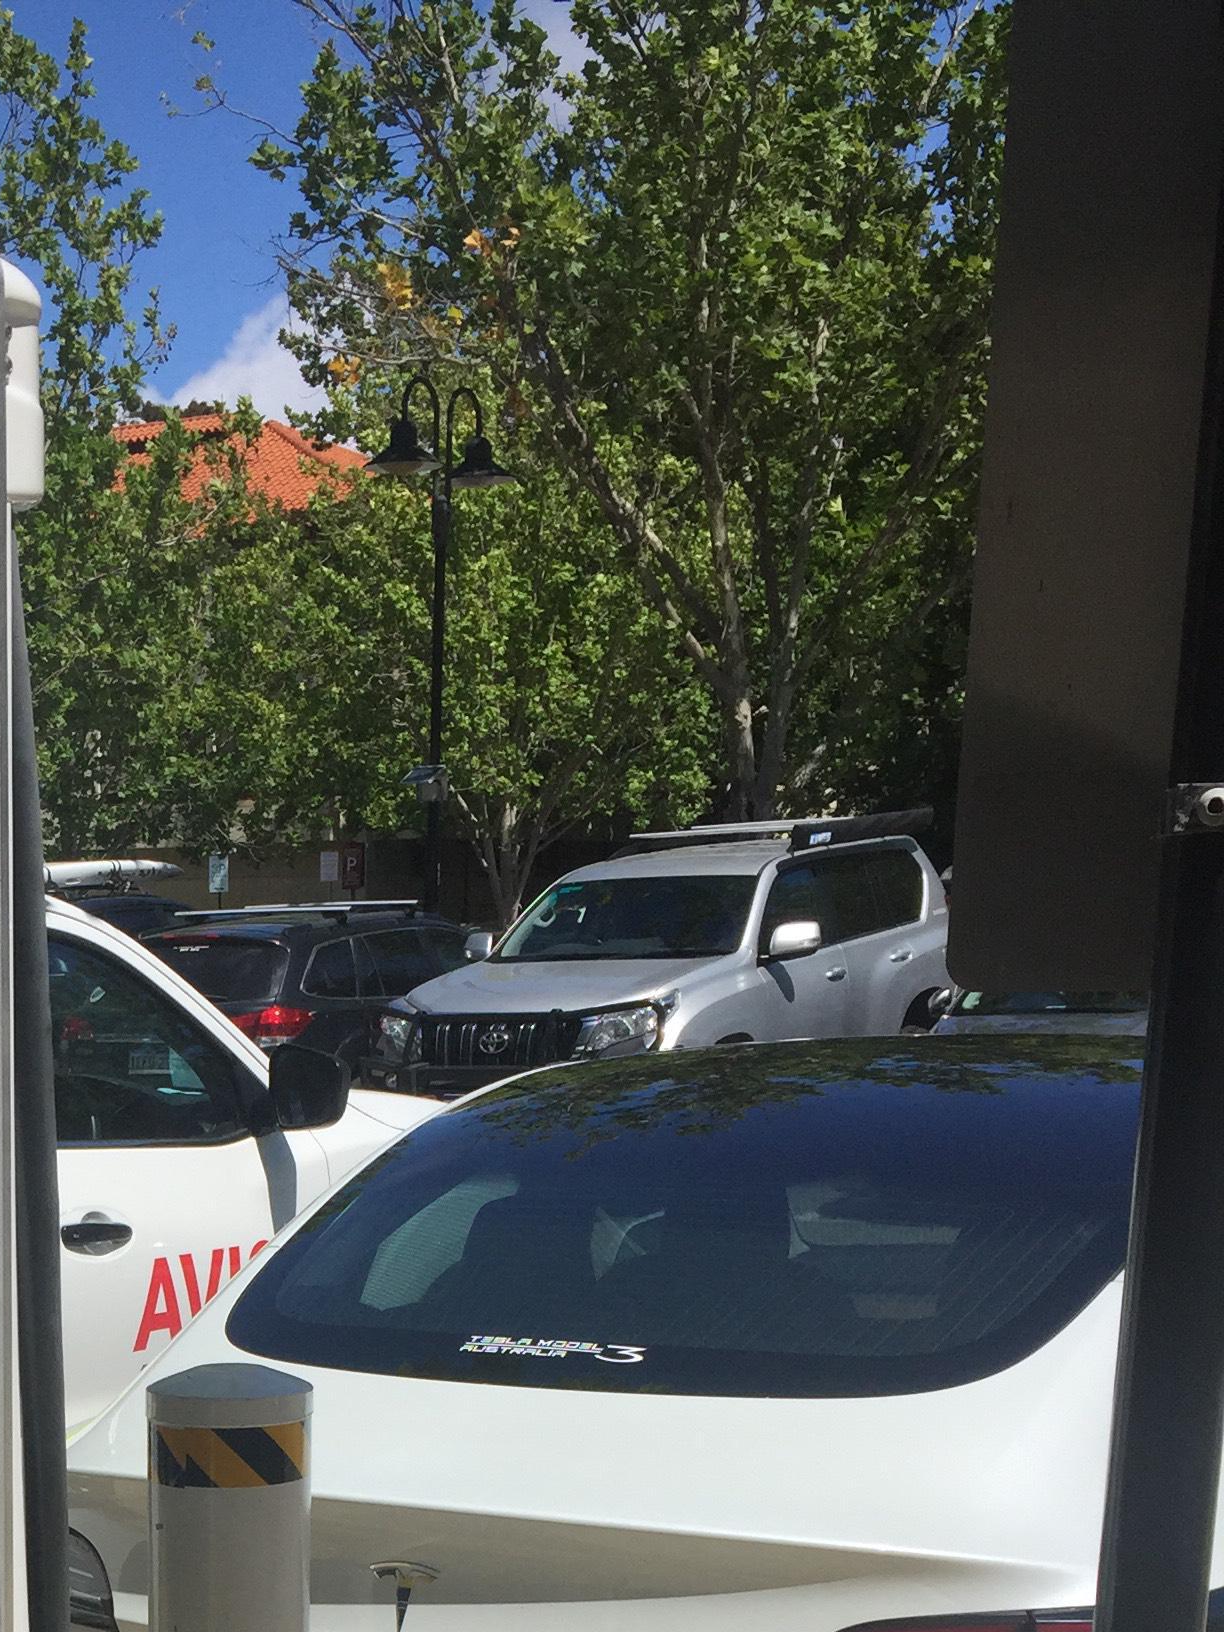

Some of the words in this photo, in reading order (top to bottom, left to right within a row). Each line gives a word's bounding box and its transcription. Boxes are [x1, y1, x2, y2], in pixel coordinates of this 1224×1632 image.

[132, 1239, 270, 1353] AV
[459, 1344, 567, 1359] AUSTRALIA
[470, 1336, 533, 1346] TESLA
[537, 1339, 604, 1351] MODEL
[594, 1344, 647, 1364] 3
